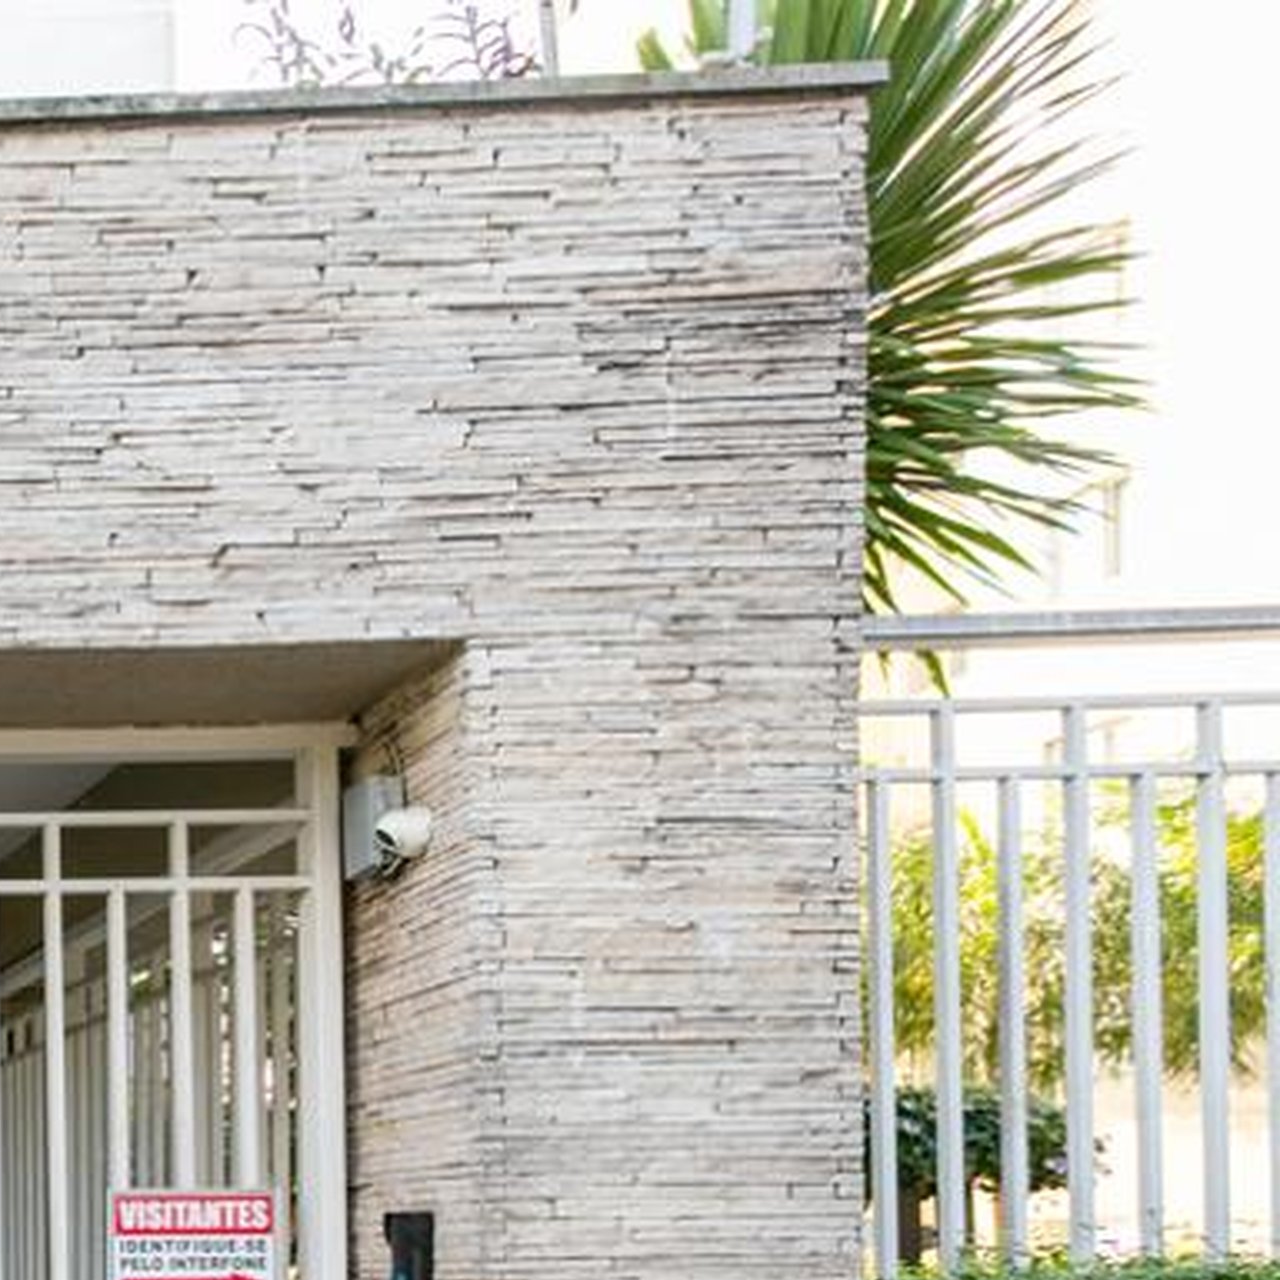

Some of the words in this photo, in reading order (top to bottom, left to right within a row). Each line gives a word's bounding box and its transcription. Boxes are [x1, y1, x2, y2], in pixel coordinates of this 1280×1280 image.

[119, 1199, 269, 1230] VISITANTES
[119, 1240, 267, 1254] IDENTIFIQUE-SE
[120, 1257, 163, 1271] PELO
[169, 1257, 267, 1271] INTERFONE
